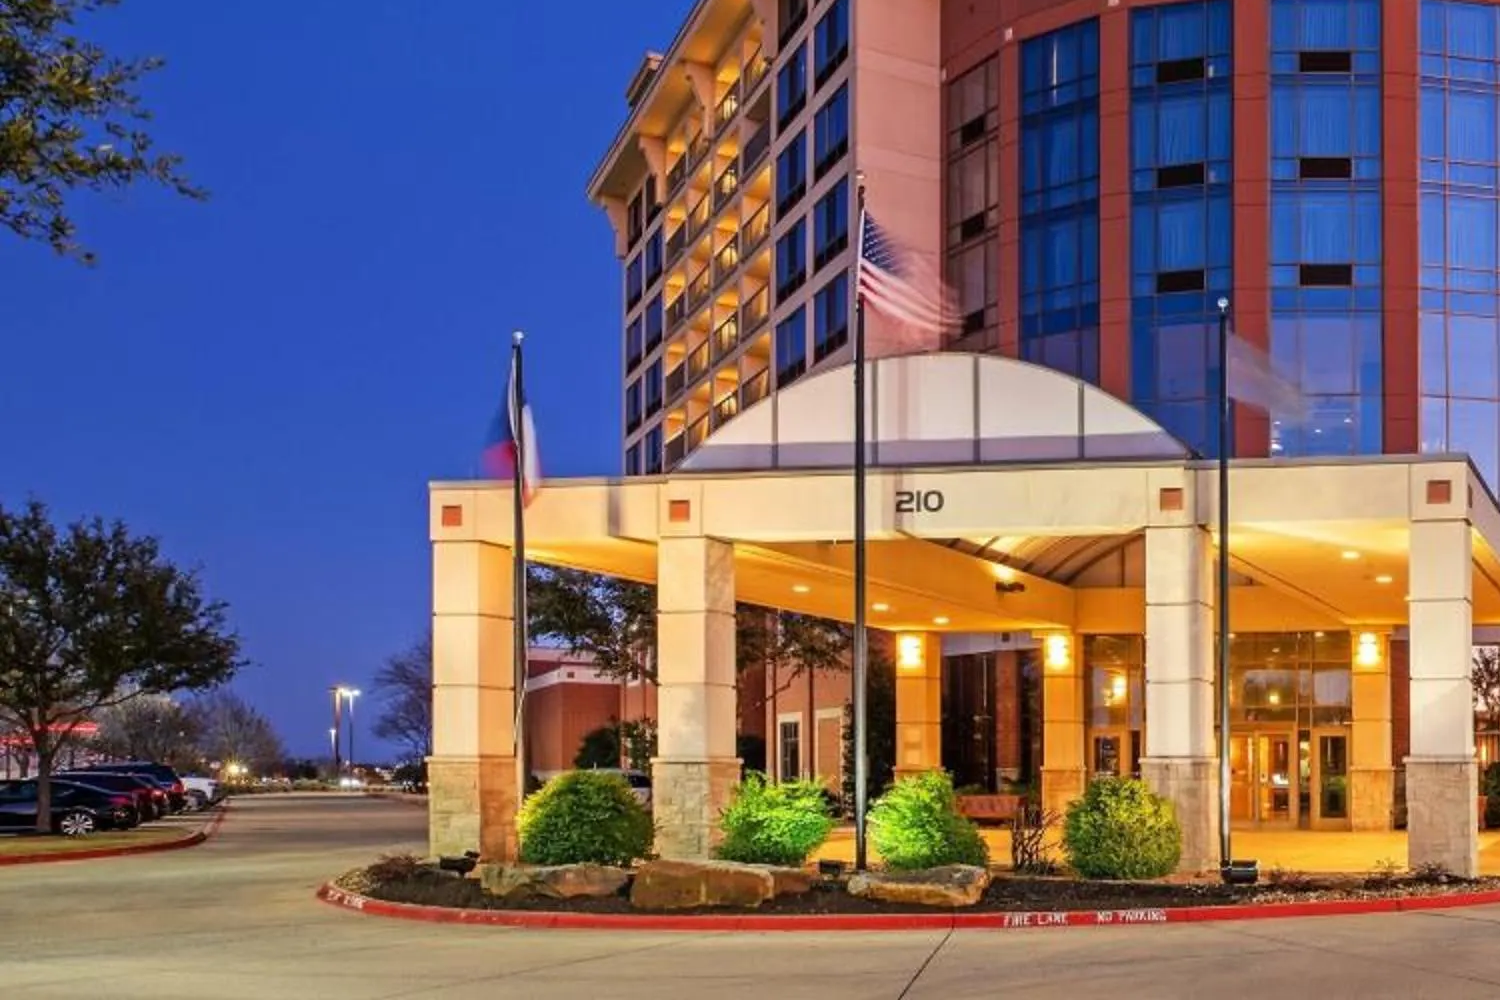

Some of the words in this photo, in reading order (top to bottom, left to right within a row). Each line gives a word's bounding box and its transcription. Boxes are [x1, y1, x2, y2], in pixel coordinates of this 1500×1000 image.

[895, 490, 944, 513] 210
[1003, 912, 1029, 927] FIRE
[1037, 911, 1068, 924] LANE
[1097, 911, 1113, 923] NO
[1119, 909, 1167, 923] PARKING
